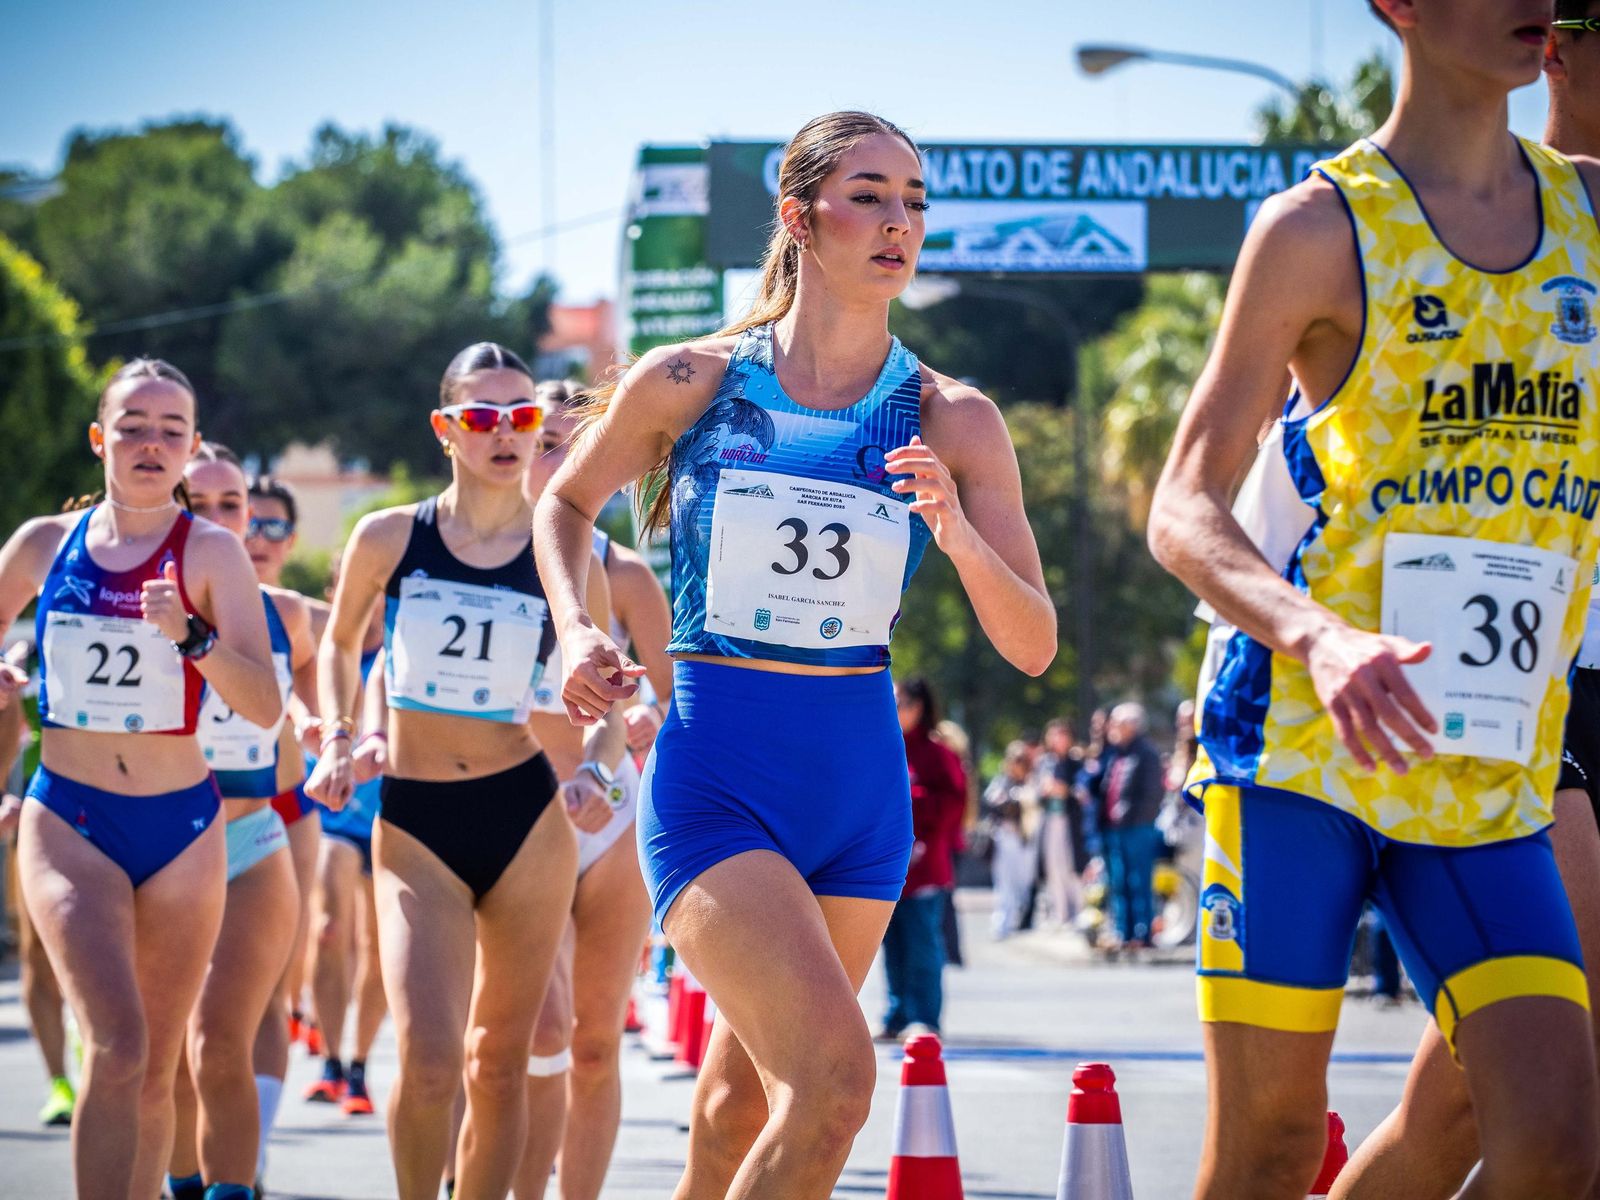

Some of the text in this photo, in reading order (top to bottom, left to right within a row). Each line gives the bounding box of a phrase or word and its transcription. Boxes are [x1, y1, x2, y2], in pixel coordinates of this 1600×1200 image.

[1022, 151, 1073, 196] DE
[1078, 150, 1287, 197] ANDALUCIA
[1473, 362, 1580, 421] Mafia
[1504, 430, 1515, 441] A
[1371, 465, 1514, 515] OLIMPO
[771, 517, 851, 580] 33
[768, 593, 846, 607] ISABEL GARCIA SANCHEZ
[439, 613, 492, 662] 21
[1459, 594, 1541, 674] 38
[86, 642, 142, 687] 22
